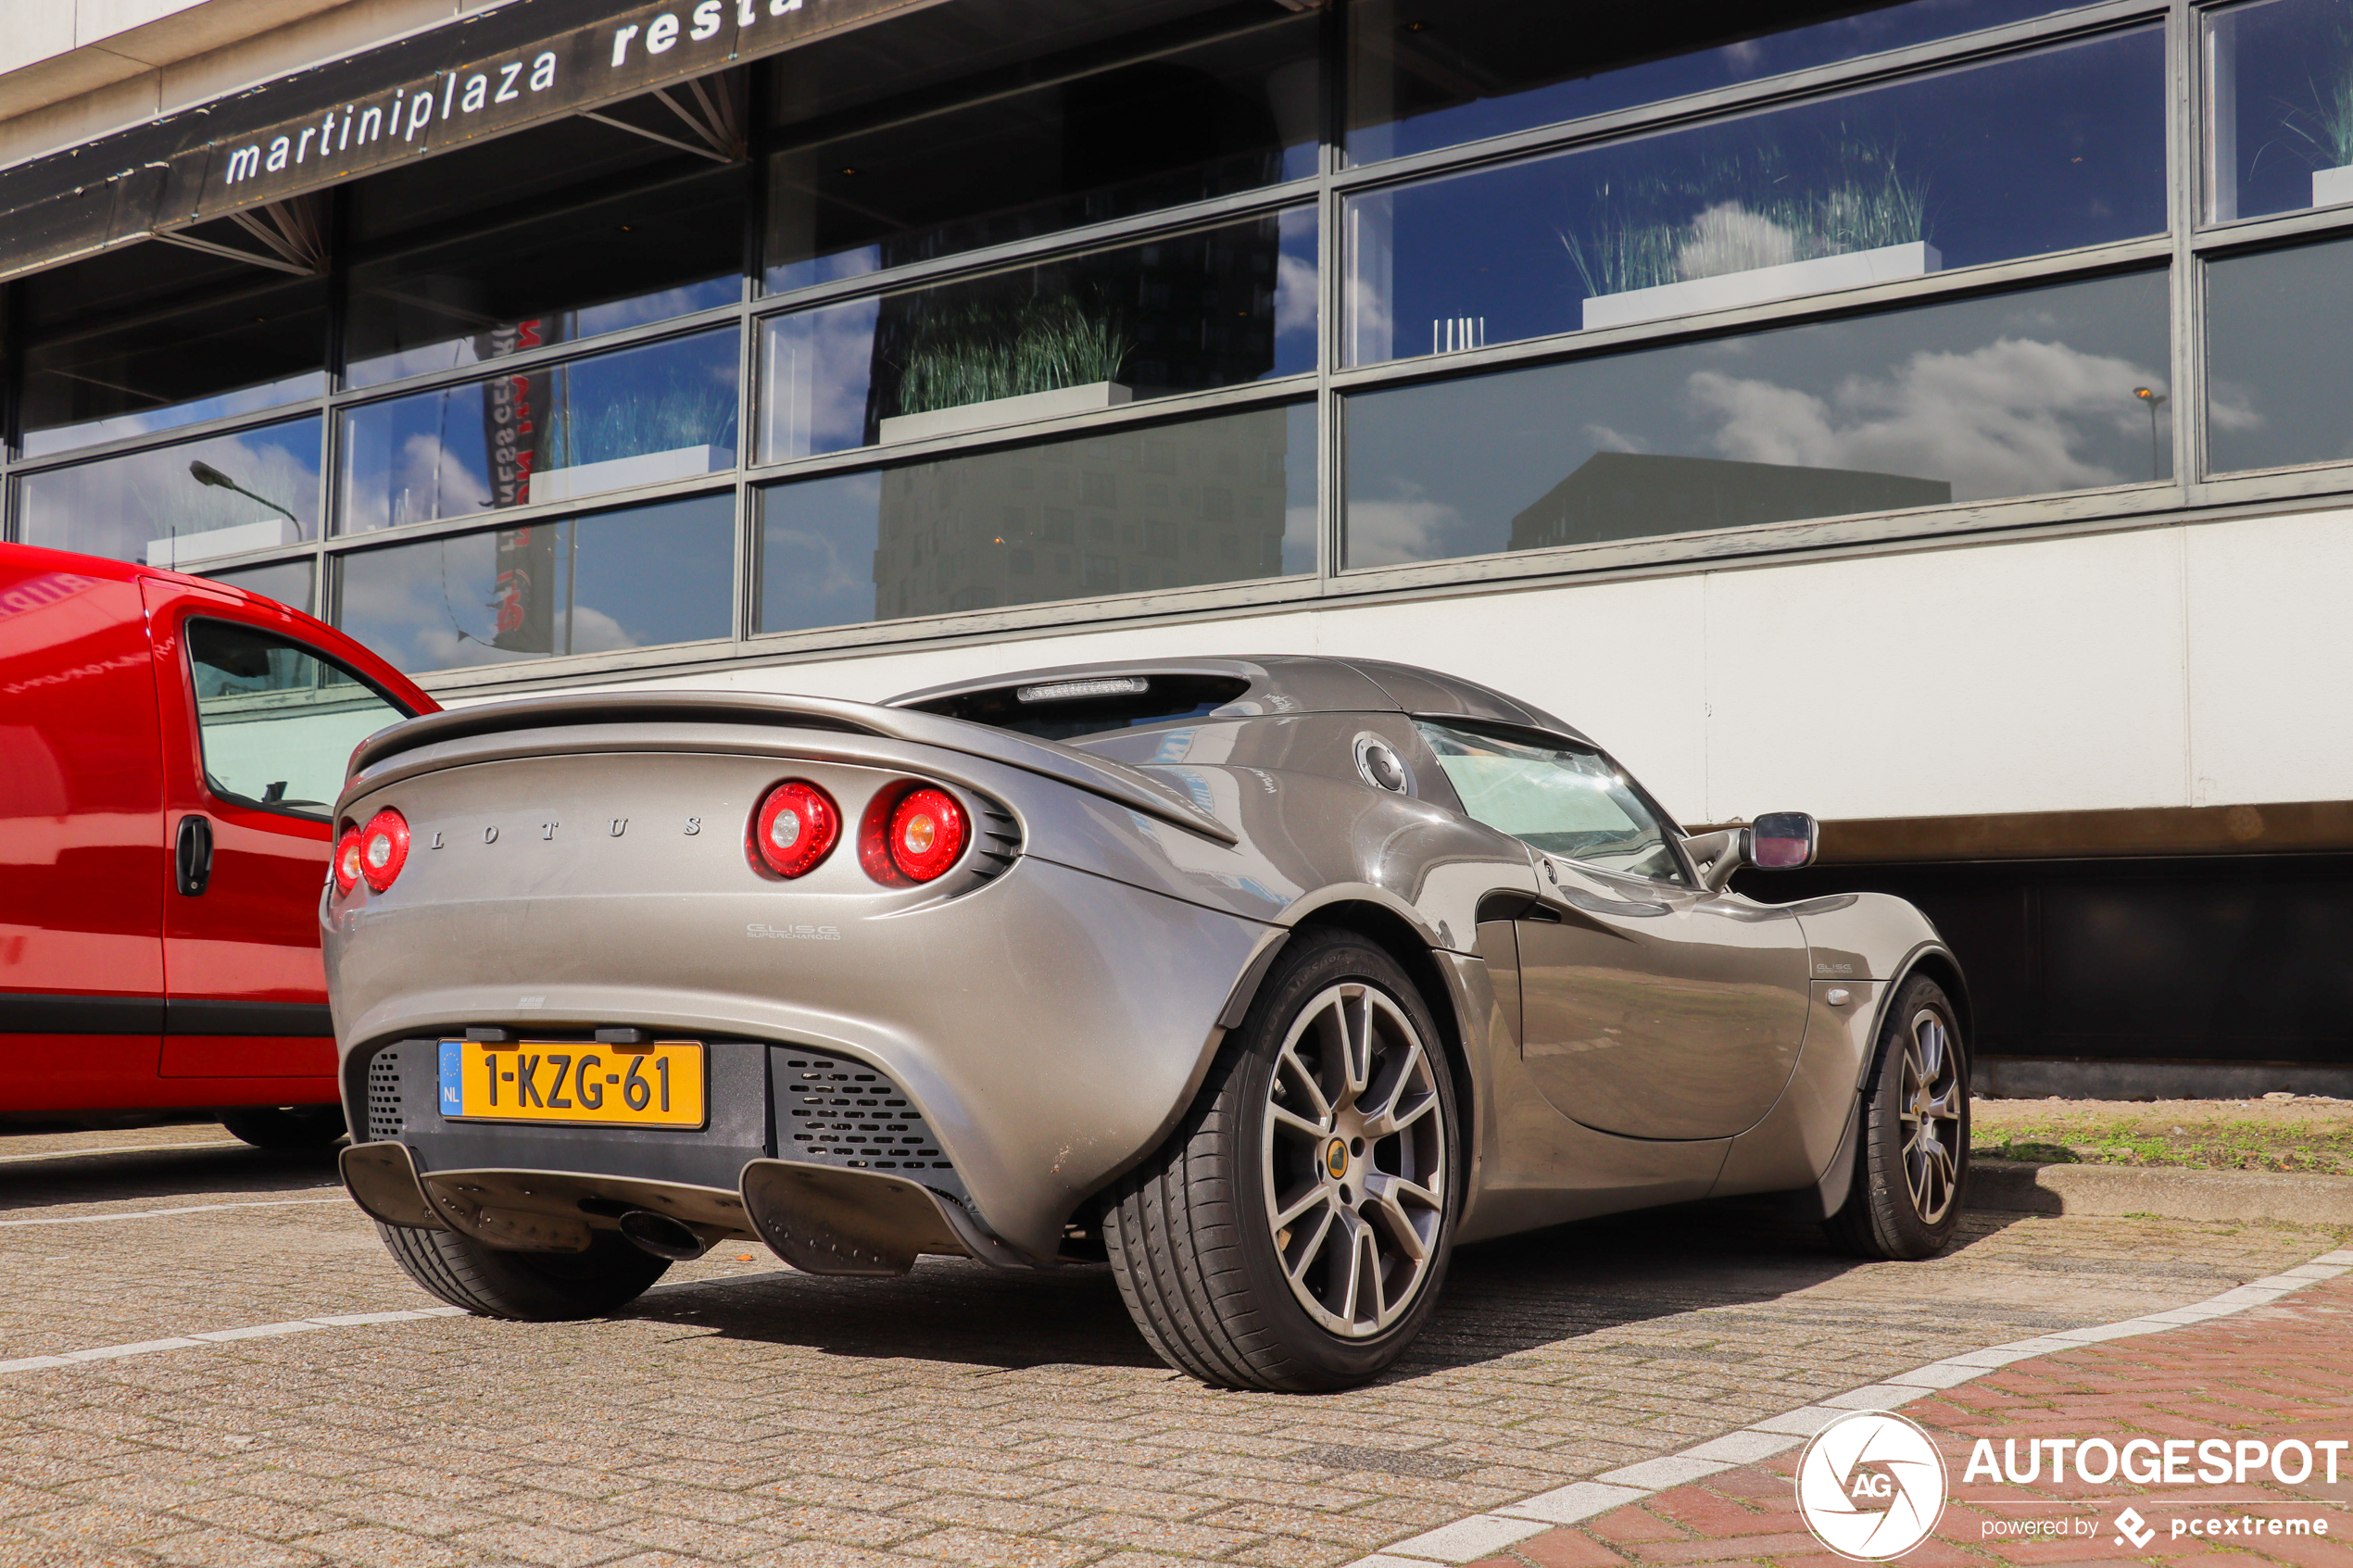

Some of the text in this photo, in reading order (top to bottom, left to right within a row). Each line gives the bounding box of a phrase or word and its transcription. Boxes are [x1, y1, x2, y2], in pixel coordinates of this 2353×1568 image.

[226, 52, 556, 184] martiniplaza
[431, 816, 701, 849] LOTUS
[747, 923, 840, 935] ELISE
[747, 932, 841, 941] SUPERCHARGED
[444, 1086, 459, 1103] NL
[484, 1053, 670, 1112] 1-KZG-61
